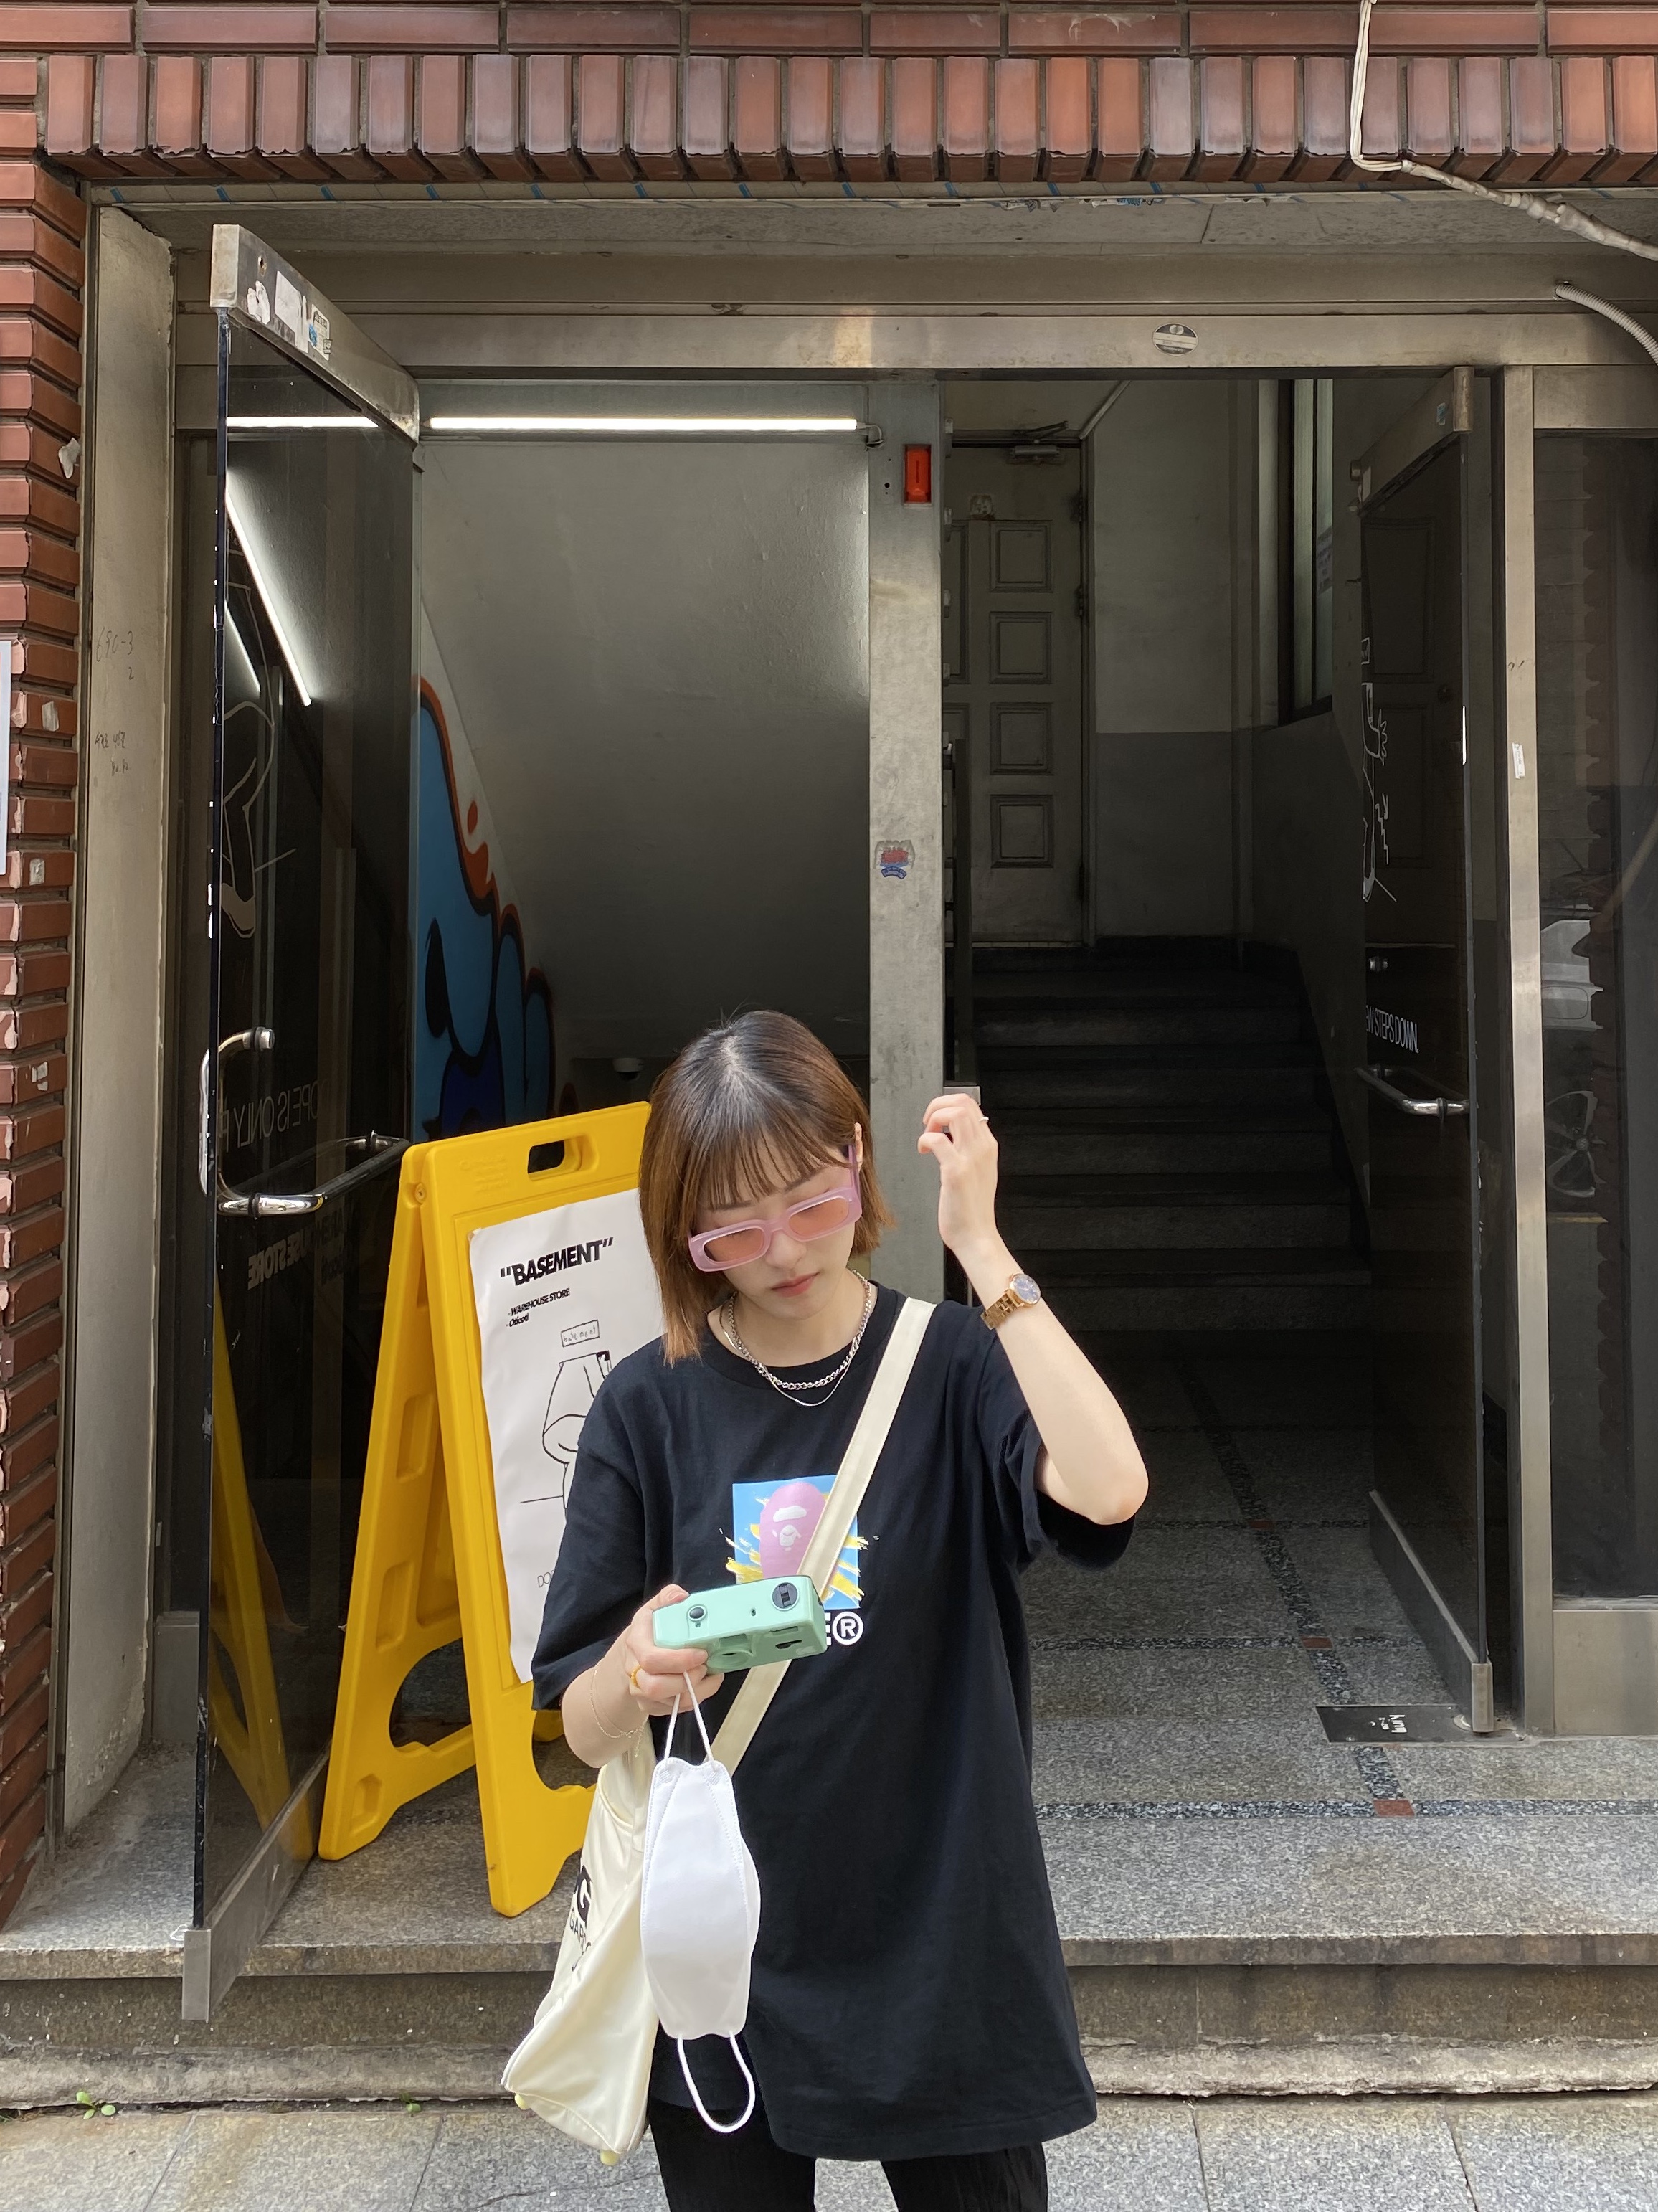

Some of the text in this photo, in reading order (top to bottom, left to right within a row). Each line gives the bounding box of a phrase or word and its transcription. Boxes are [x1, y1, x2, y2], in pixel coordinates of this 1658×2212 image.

[1374, 1008, 1395, 1043] STEPS
[1394, 1016, 1419, 1054] DOWN.
[500, 1237, 614, 1286] "BASEMENT"
[511, 1294, 549, 1316] WAREHOUSE
[549, 1287, 571, 1302] STORE
